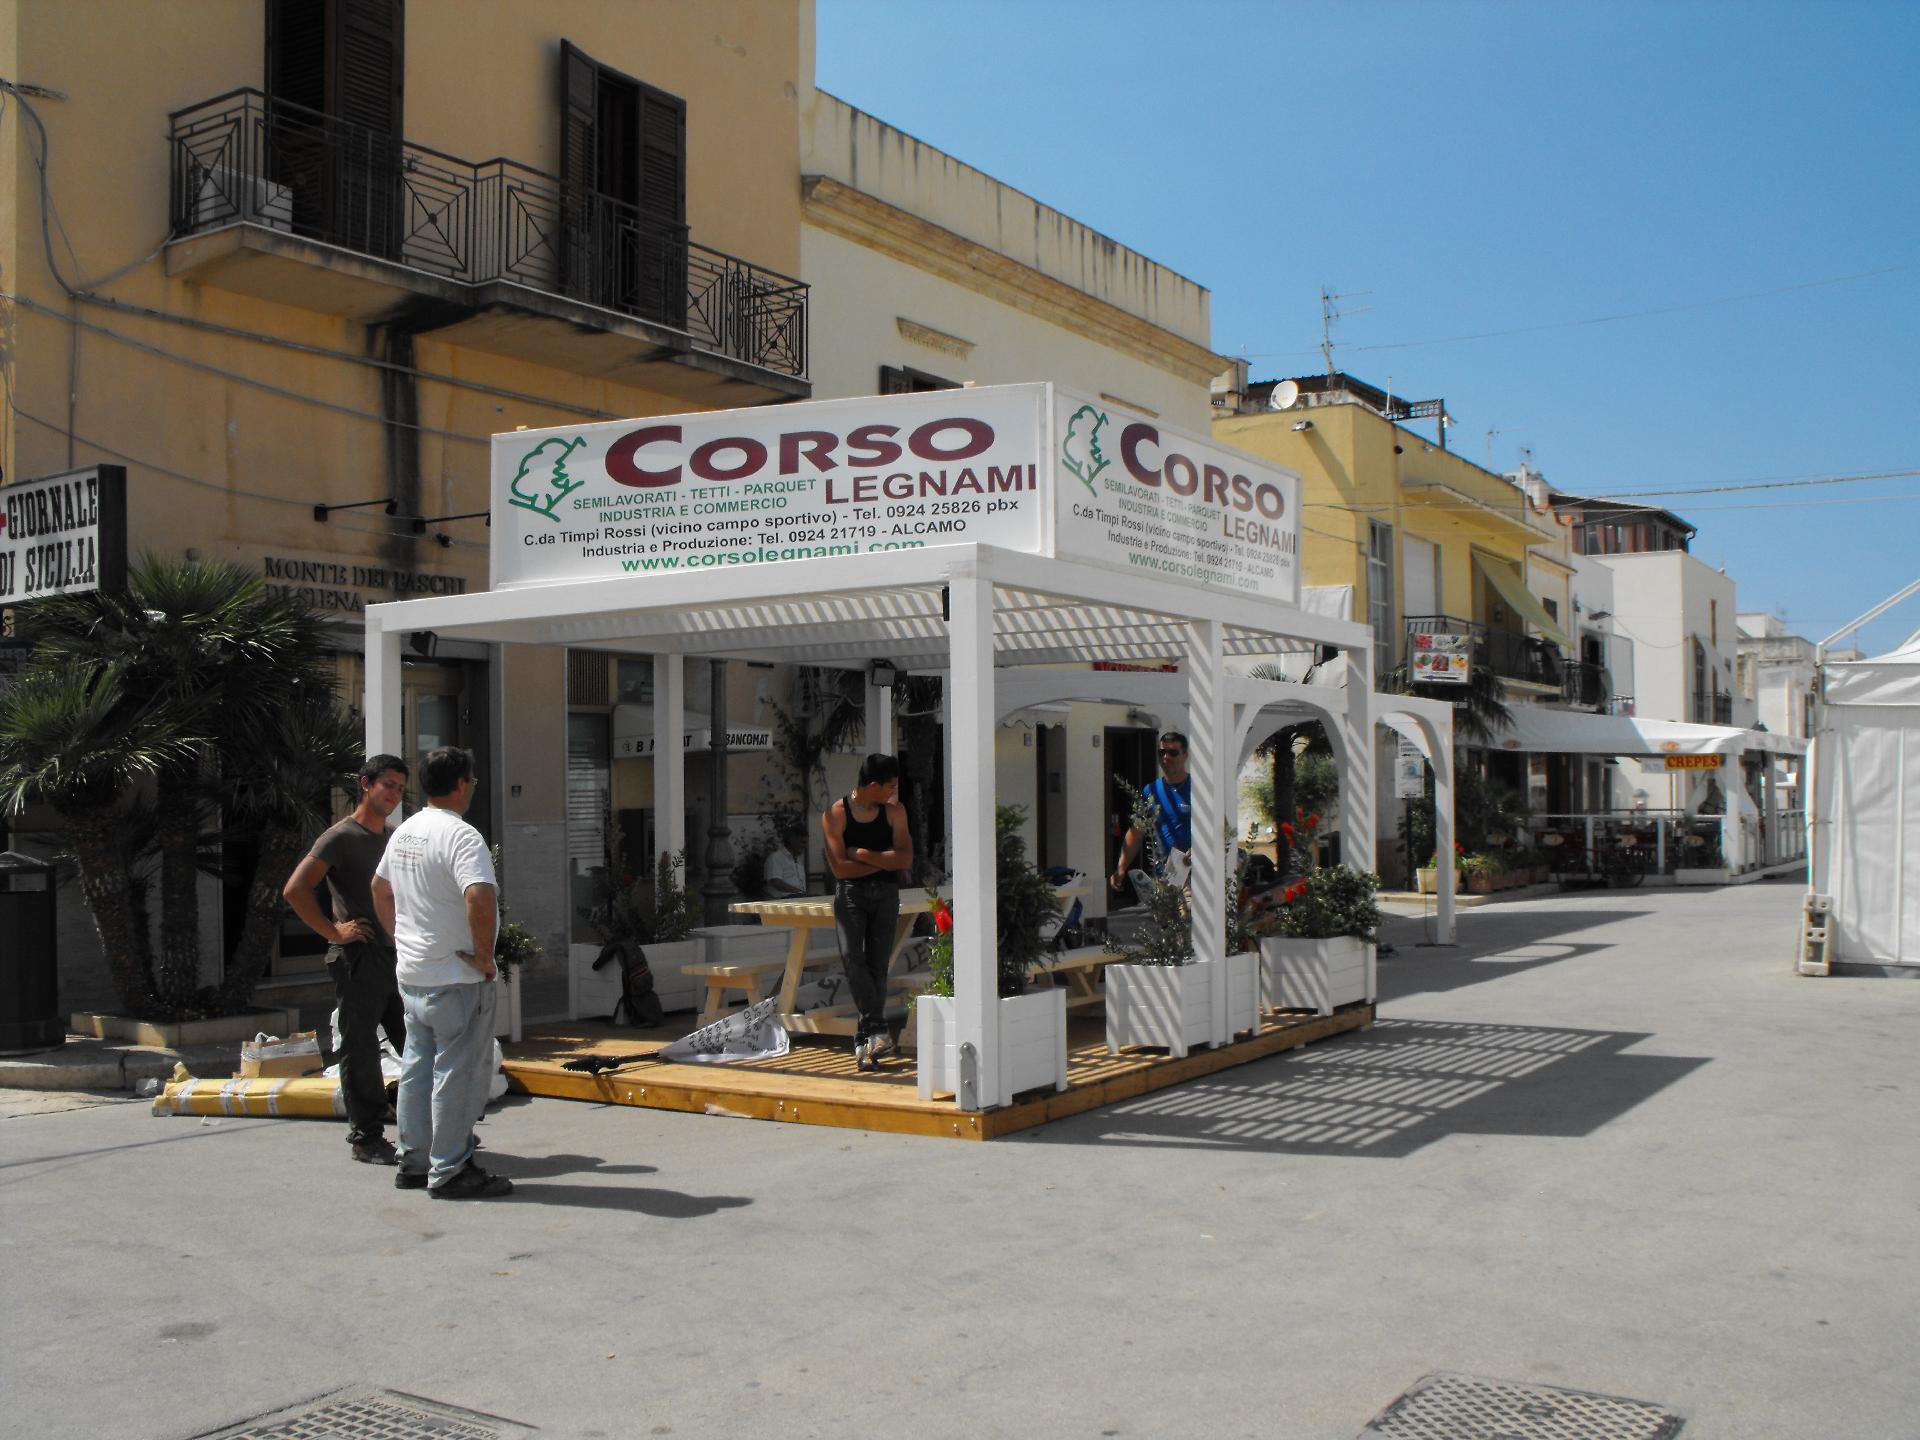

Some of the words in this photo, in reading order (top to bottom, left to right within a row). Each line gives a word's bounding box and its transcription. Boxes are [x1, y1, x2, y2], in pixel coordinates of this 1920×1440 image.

[604, 417, 995, 488] CORSO
[825, 463, 1037, 504] LEGNAMI
[1120, 423, 1284, 520] CORSO
[573, 490, 677, 509] SEMILAVORATI
[690, 486, 730, 499] TETTI
[744, 479, 816, 495] PARQUET
[1104, 478, 1160, 503] SEMILAVORATI
[7, 477, 98, 540] GIORNALE
[524, 533, 556, 546] C.da
[560, 529, 599, 544] Timpi
[604, 525, 646, 539] Rossi
[651, 522, 702, 538] (vicino
[707, 518, 759, 532] campo
[765, 511, 837, 528] sportivo)
[853, 507, 881, 519] Tel.
[886, 504, 926, 518] 0924
[931, 500, 981, 515] 25826
[986, 499, 1019, 514] pbx
[599, 508, 675, 523] INDUSTRIA
[680, 505, 688, 516] E
[693, 497, 788, 515] COMMERCIO
[1073, 503, 1094, 518] C.da
[1096, 508, 1119, 527] Timpi
[1121, 515, 1144, 532] Rossi
[1119, 498, 1159, 518] INDUSTRIA
[582, 543, 645, 558] Industria
[649, 544, 658, 552] e
[662, 535, 752, 551] Produzione:
[757, 532, 784, 545] Tel.
[788, 529, 826, 543] 0924
[830, 525, 876, 540] 21719
[891, 519, 967, 535] ALCAMO
[1108, 530, 1142, 548] Industria
[1144, 541, 1149, 549] e
[1223, 514, 1296, 555] LEGNAMI
[25, 536, 96, 593] SICILIA
[263, 556, 347, 585] MONTE
[352, 566, 385, 588] DEI
[393, 571, 467, 596] PASCHI
[296, 586, 361, 611] SIENA
[725, 733, 769, 747] BANCOMAT
[1666, 754, 1719, 769] CREPES
